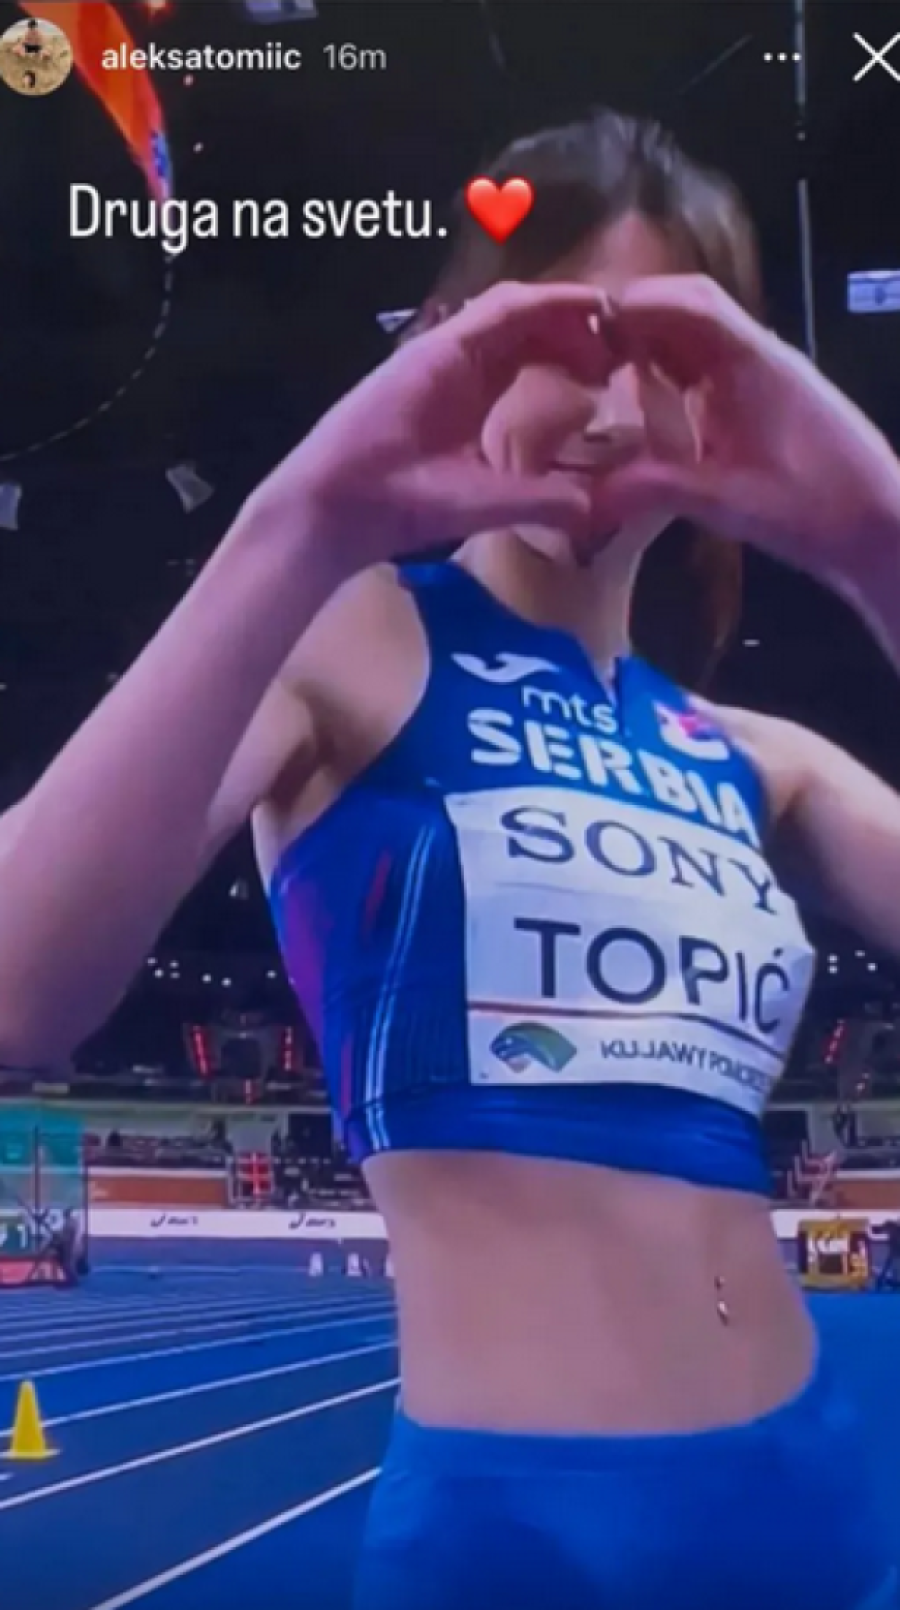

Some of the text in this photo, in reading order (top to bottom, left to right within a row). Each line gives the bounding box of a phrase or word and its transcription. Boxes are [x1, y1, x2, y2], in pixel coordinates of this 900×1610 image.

[521, 685, 618, 734] mts
[467, 709, 760, 848] SERBIA
[499, 806, 778, 916] SONY
[513, 917, 791, 1033] TOPIĆ
